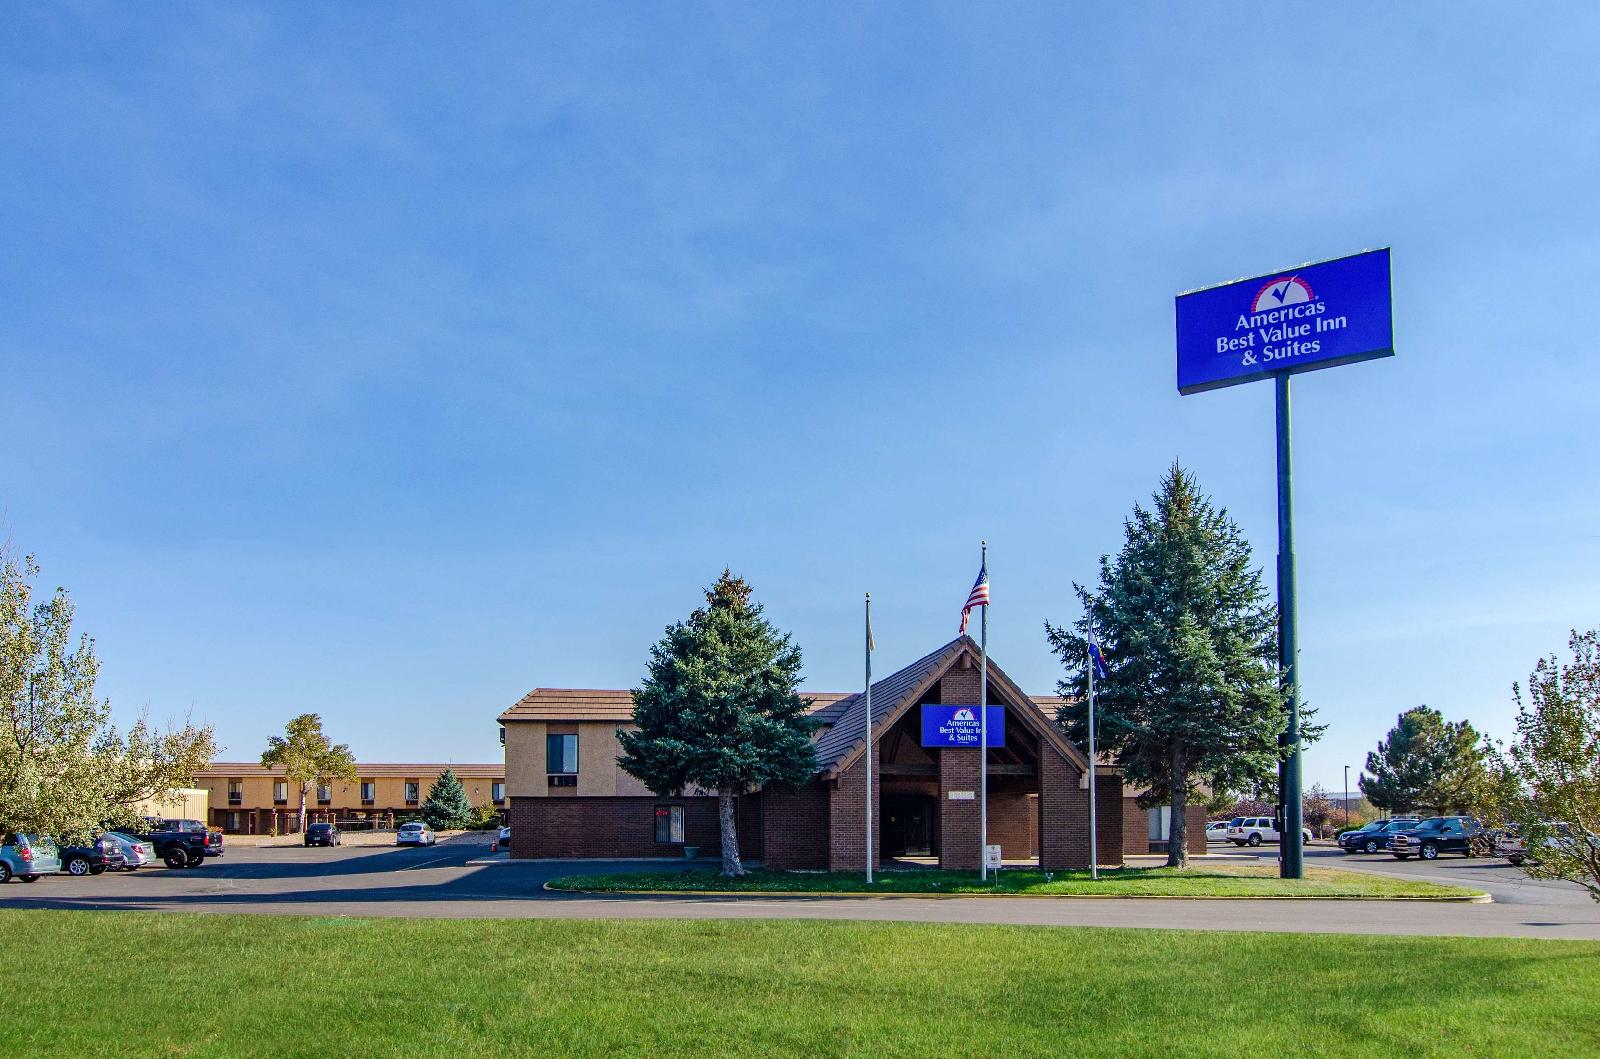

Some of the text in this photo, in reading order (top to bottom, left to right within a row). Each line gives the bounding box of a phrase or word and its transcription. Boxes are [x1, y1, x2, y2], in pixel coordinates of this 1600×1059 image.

[1235, 300, 1326, 331] Americas
[1216, 315, 1347, 353] Best Value Inn
[1241, 339, 1321, 366] & Suites
